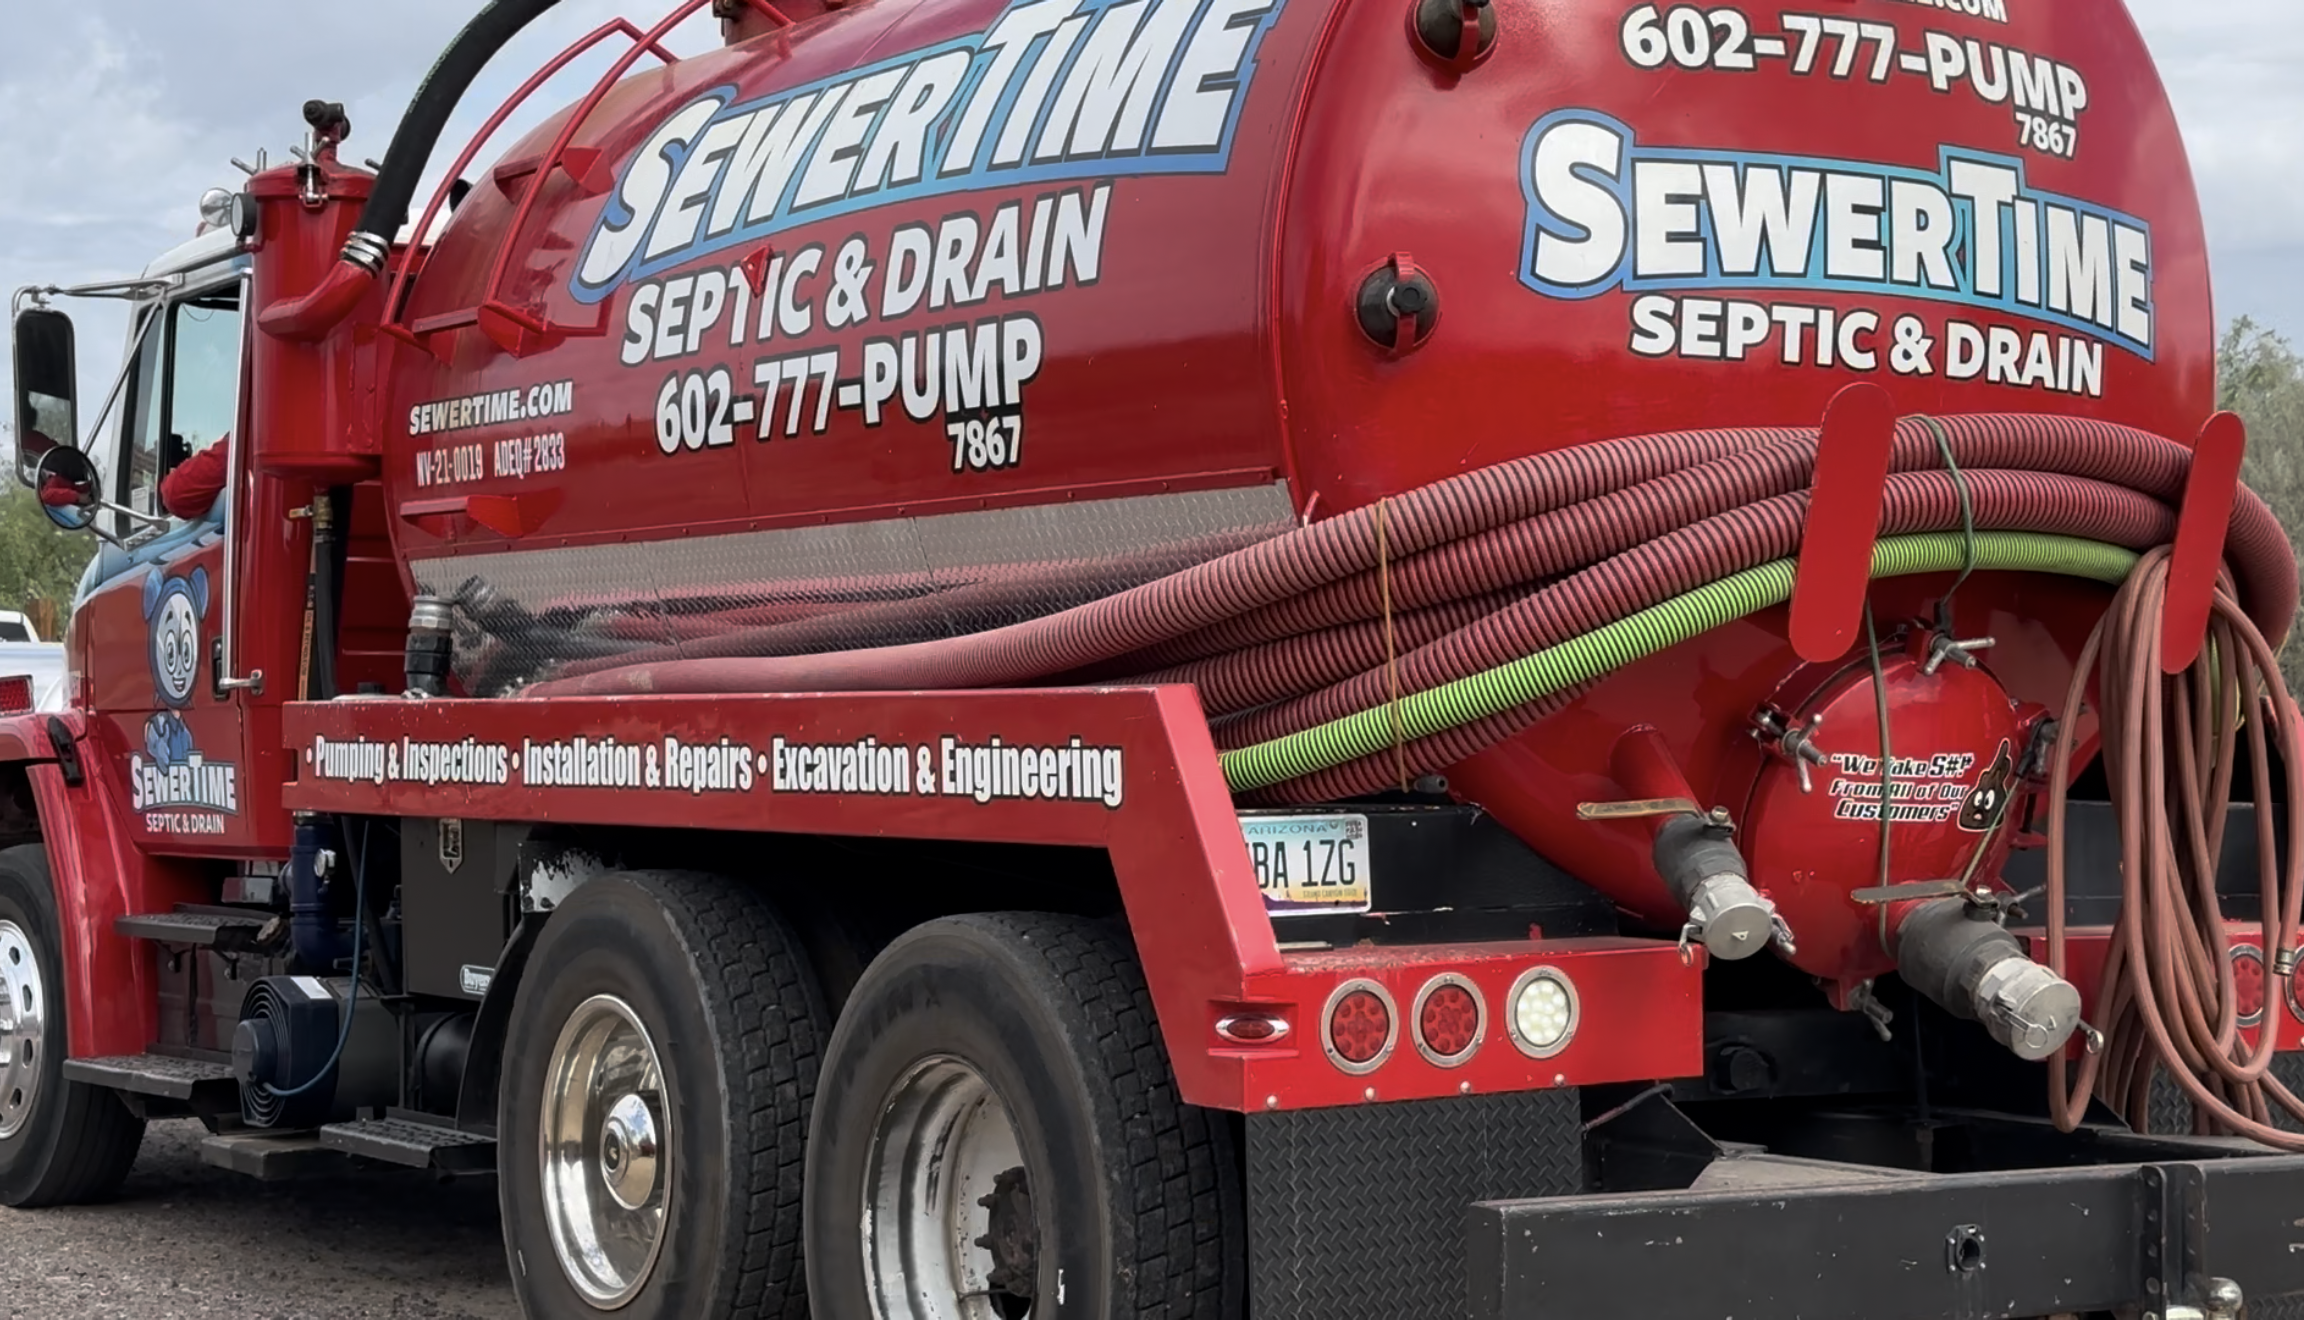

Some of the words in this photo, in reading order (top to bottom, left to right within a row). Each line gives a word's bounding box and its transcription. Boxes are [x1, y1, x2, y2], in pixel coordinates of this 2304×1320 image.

[1621, 5, 2088, 120] 602-777-PUMP
[580, 0, 1274, 287] SEWERTIME
[2014, 112, 2077, 157] 7867
[1533, 121, 2150, 343] SEWERTIME
[619, 247, 821, 365] SEPTIC
[825, 244, 870, 328] &
[882, 185, 1111, 320] DRAIN
[1631, 295, 1878, 369] SEPTIC
[1889, 316, 1933, 374] &
[1945, 322, 2103, 397] DRAIN
[409, 381, 573, 436] SEWERTIME.COM
[655, 319, 1042, 456] 602-777-PUMP
[949, 418, 1022, 471] 7867
[131, 754, 237, 811] SEWERTIME
[315, 735, 385, 784] Pumping
[387, 742, 400, 780] &
[403, 736, 508, 785] Inspections
[523, 737, 641, 786] Installation
[645, 743, 661, 788] &
[665, 737, 753, 794] Repairs
[773, 737, 910, 793] Excavation
[916, 745, 936, 794] &
[941, 738, 1123, 807] Engineering
[1831, 780, 1884, 797] From
[1888, 783, 1914, 799] All
[1915, 783, 1938, 799] of
[1880, 756, 1929, 777] ake
[146, 812, 182, 834] SEPTIC
[181, 812, 191, 834] &
[190, 813, 225, 835] DRAIN
[1247, 824, 1329, 836] ARIZONA
[1245, 841, 1290, 889] BA
[1301, 839, 1357, 887] 1ZG
